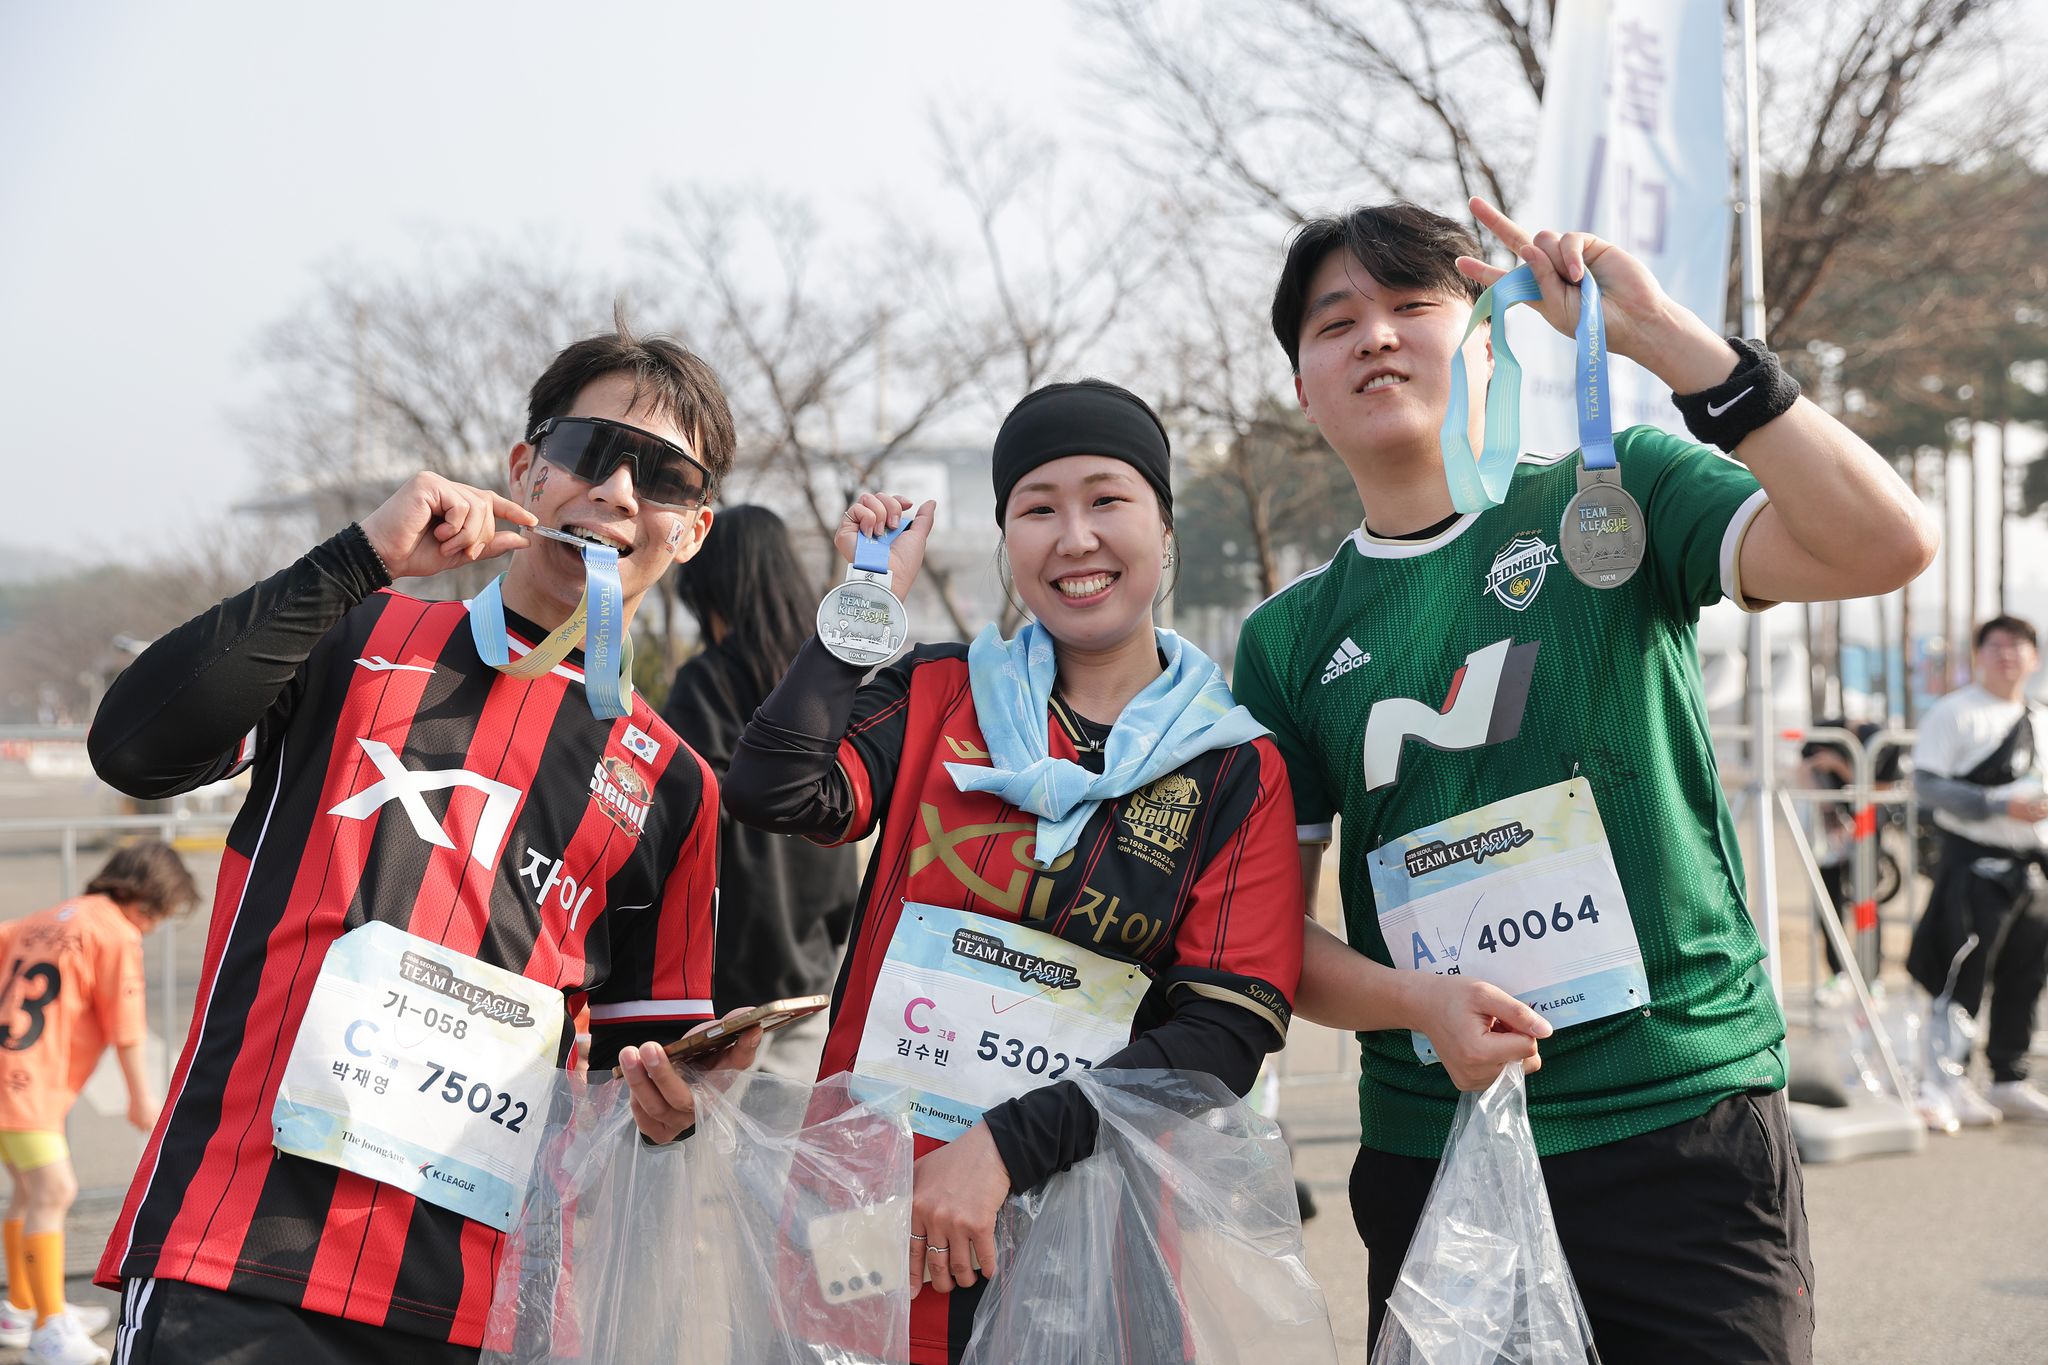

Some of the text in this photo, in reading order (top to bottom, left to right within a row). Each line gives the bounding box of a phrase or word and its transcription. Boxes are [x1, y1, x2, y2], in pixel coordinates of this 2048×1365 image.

[1588, 375, 1598, 383] K
[1589, 386, 1600, 420] TEAM
[1579, 507, 1607, 519] TEAM
[1580, 517, 1627, 532] K LEAGUE
[1486, 547, 1555, 591] JEONBUK
[1600, 574, 1616, 582] 10KM
[601, 585, 610, 616] TEAM
[838, 605, 889, 620] K LEAGUE
[840, 596, 870, 608] TEAM
[849, 651, 867, 660] 10KM
[1321, 652, 1371, 684] adidas
[590, 762, 650, 835] Seoul
[1124, 793, 1196, 841] Seoul
[1132, 850, 1173, 876] ANNIVERSARY
[1408, 825, 1521, 874] TEAM K LEAGUE
[1416, 849, 1433, 857] SEOUL
[519, 847, 593, 932] 자이
[958, 931, 989, 944] 2026 SEOUL
[1070, 886, 1163, 957] 자이
[1477, 894, 1600, 954] 40064
[419, 959, 438, 973] SEOUL
[956, 938, 1073, 982] TEAM K LEAGUE
[1412, 931, 1437, 970] A
[403, 961, 526, 1020] TEAM K LEAGUE
[1245, 984, 1276, 1004] Soul
[1540, 993, 1586, 1012] K LEAGUE
[383, 990, 468, 1040] 가-058
[904, 997, 936, 1034] C
[344, 1018, 380, 1058] C
[418, 1061, 529, 1134] 75022
[910, 1101, 973, 1128] The JoongAng
[342, 1130, 405, 1164] The JoongAng
[432, 1170, 476, 1193] K LEAGUE
